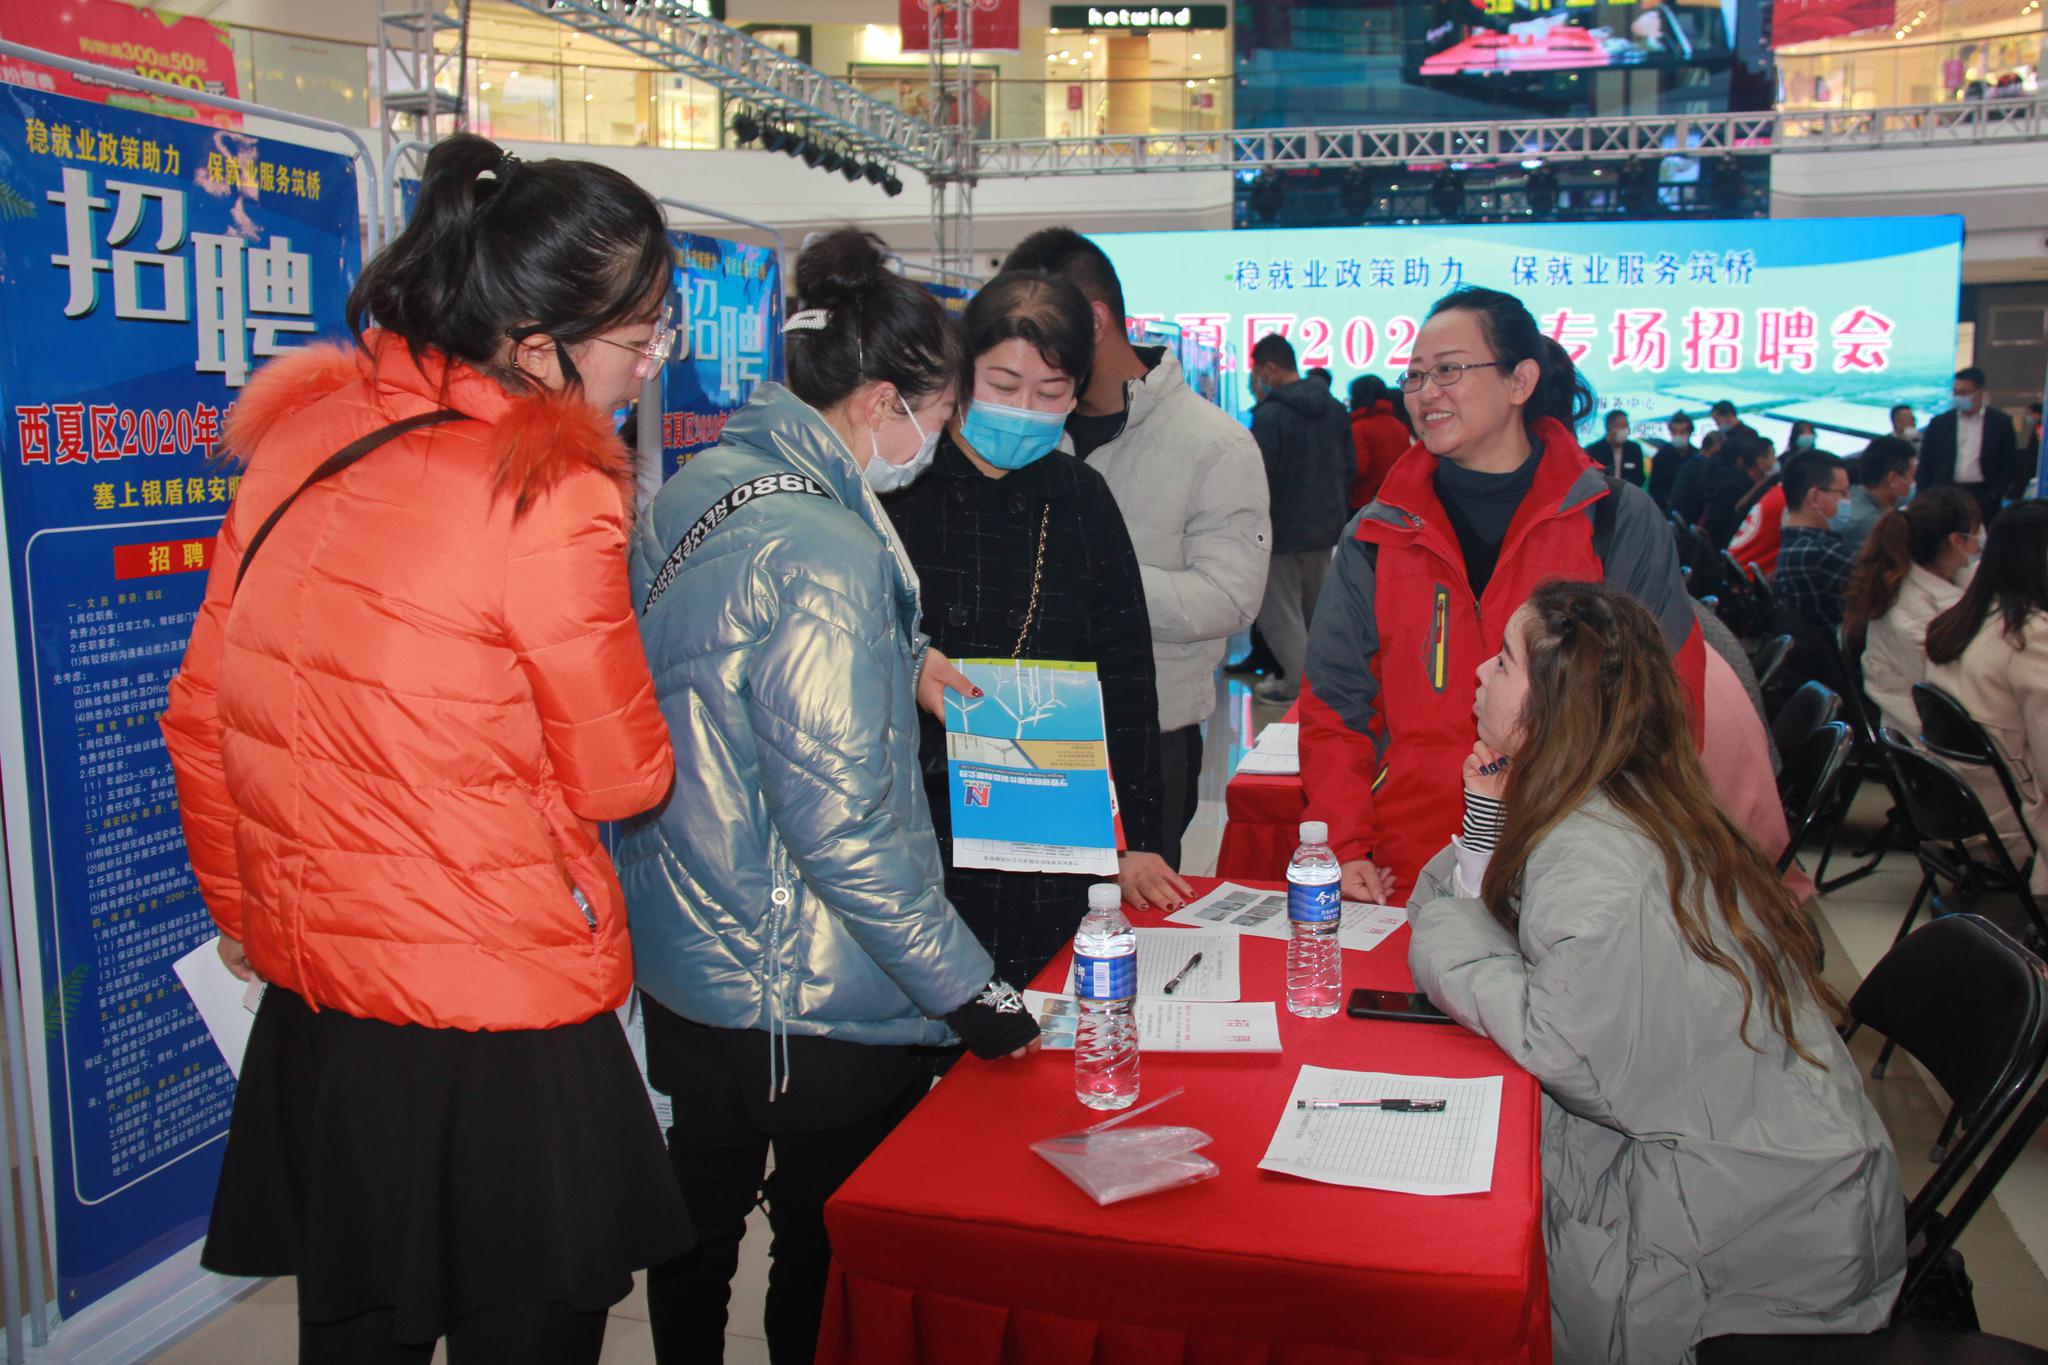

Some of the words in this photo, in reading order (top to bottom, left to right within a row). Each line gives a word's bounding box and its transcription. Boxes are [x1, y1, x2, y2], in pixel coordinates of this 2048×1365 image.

[1088, 7, 1191, 26] hotwind
[25, 118, 181, 176] 稳就业政策助力
[206, 151, 322, 200] 保就业服务筑桥
[46, 166, 317, 388] 招聘
[1233, 256, 1462, 288] 稳就业政策助力
[1511, 249, 1755, 286] 保就业服务筑桥
[676, 272, 764, 401] 招聘
[1543, 307, 1896, 372] 专场招聘会
[732, 474, 823, 507] 1980
[148, 542, 204, 573] 招聘
